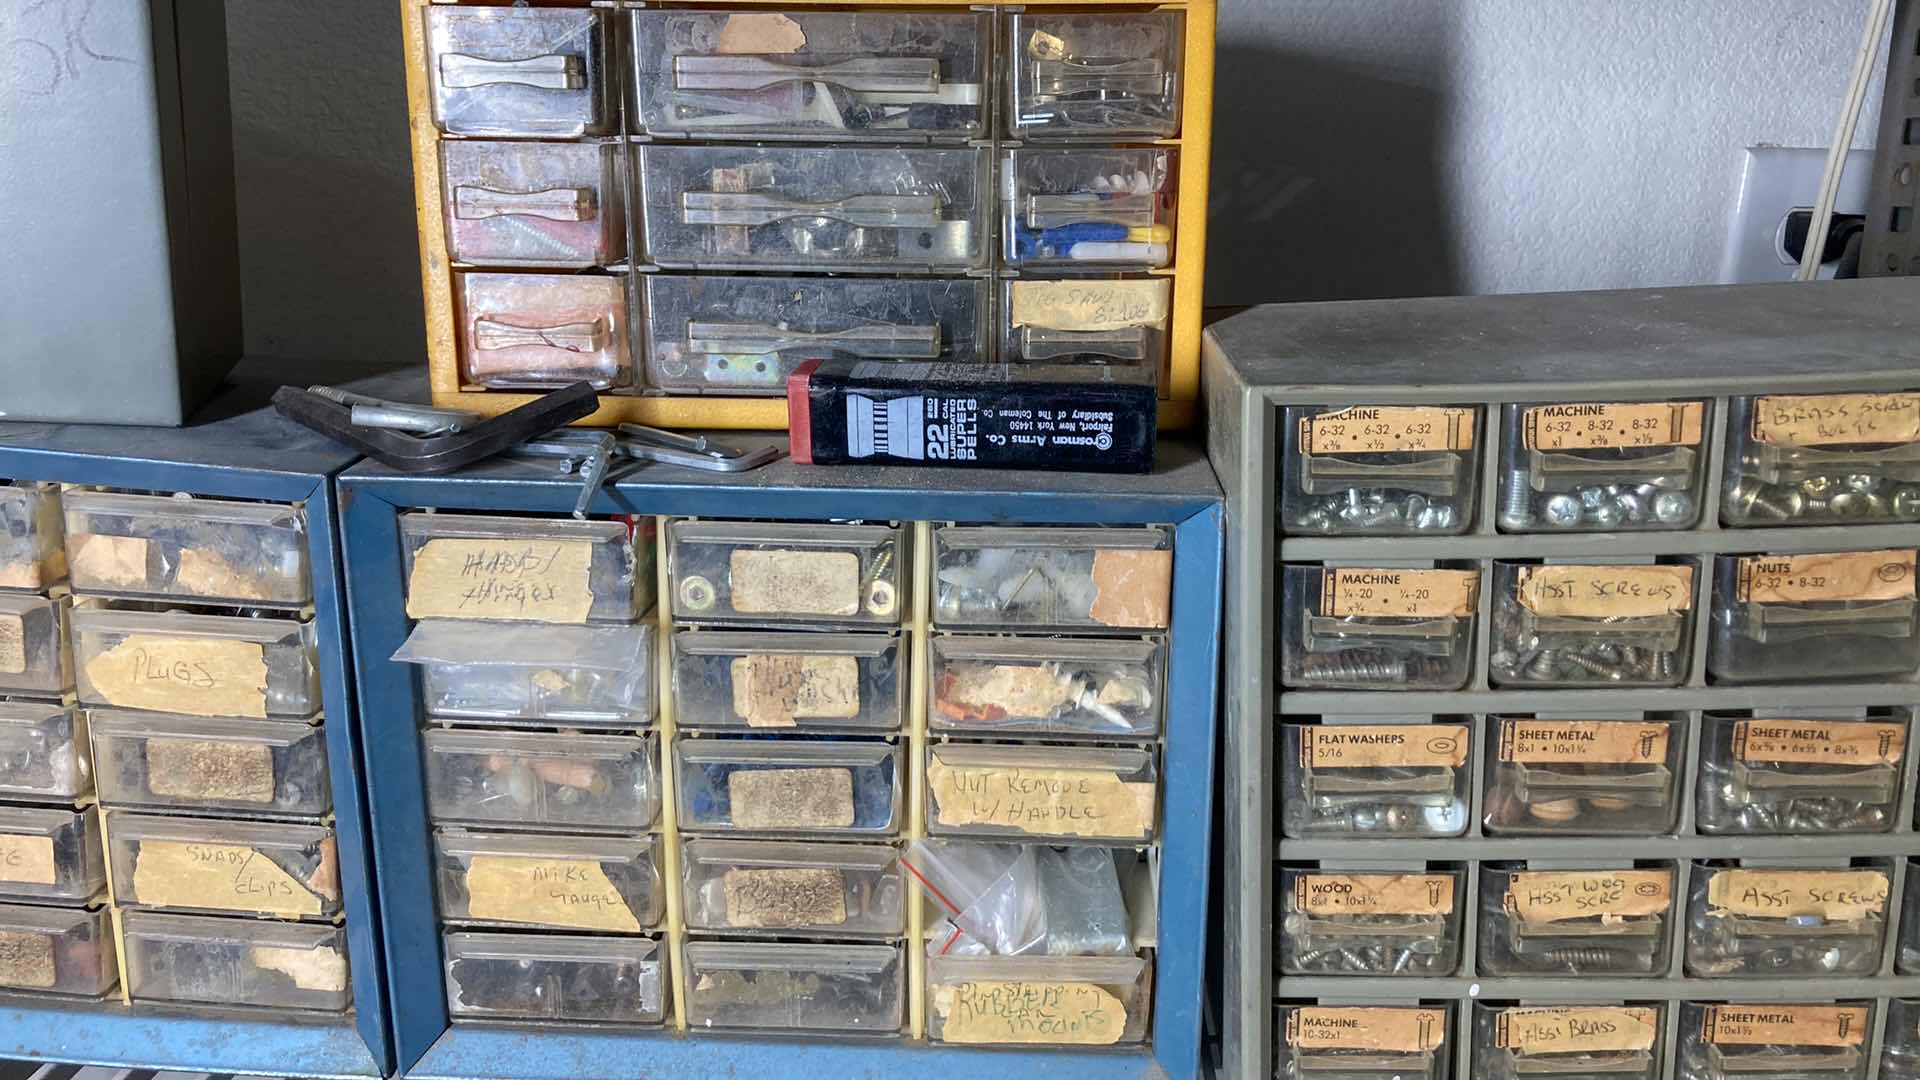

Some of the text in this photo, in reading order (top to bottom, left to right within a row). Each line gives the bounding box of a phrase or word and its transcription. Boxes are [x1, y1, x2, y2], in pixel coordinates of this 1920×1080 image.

[999, 409, 1032, 419] Coleman
[1038, 410, 1052, 420] The
[1057, 410, 1067, 420] of
[1071, 409, 1114, 422] Subsidiary
[1317, 409, 1380, 421] ACHINE
[1543, 405, 1606, 417] MACHINE
[957, 399, 967, 460] SUPER
[967, 399, 977, 460] PELLS
[1009, 421, 1113, 433] Fairport, New York 14450
[1319, 424, 1431, 437] 6-32 6-32 6-32
[1545, 418, 1658, 433] 6-32 8-32 8-32
[927, 424, 949, 459] 22
[985, 432, 1113, 450] Crosman Arms Co.
[1756, 563, 1792, 574] NUTS
[1342, 574, 1400, 585] MACHINE
[1754, 576, 1826, 589] 6-32 8-32
[1319, 734, 1405, 745] FLAT WASHERS
[1519, 729, 1595, 742] SHEET METAL
[1751, 727, 1831, 741] SHEET METAL
[1318, 748, 1343, 759] 5/16
[1311, 883, 1352, 894] WOOD
[1303, 1017, 1360, 1028] MACHINE
[1720, 1013, 1795, 1024] SHEET METAL
